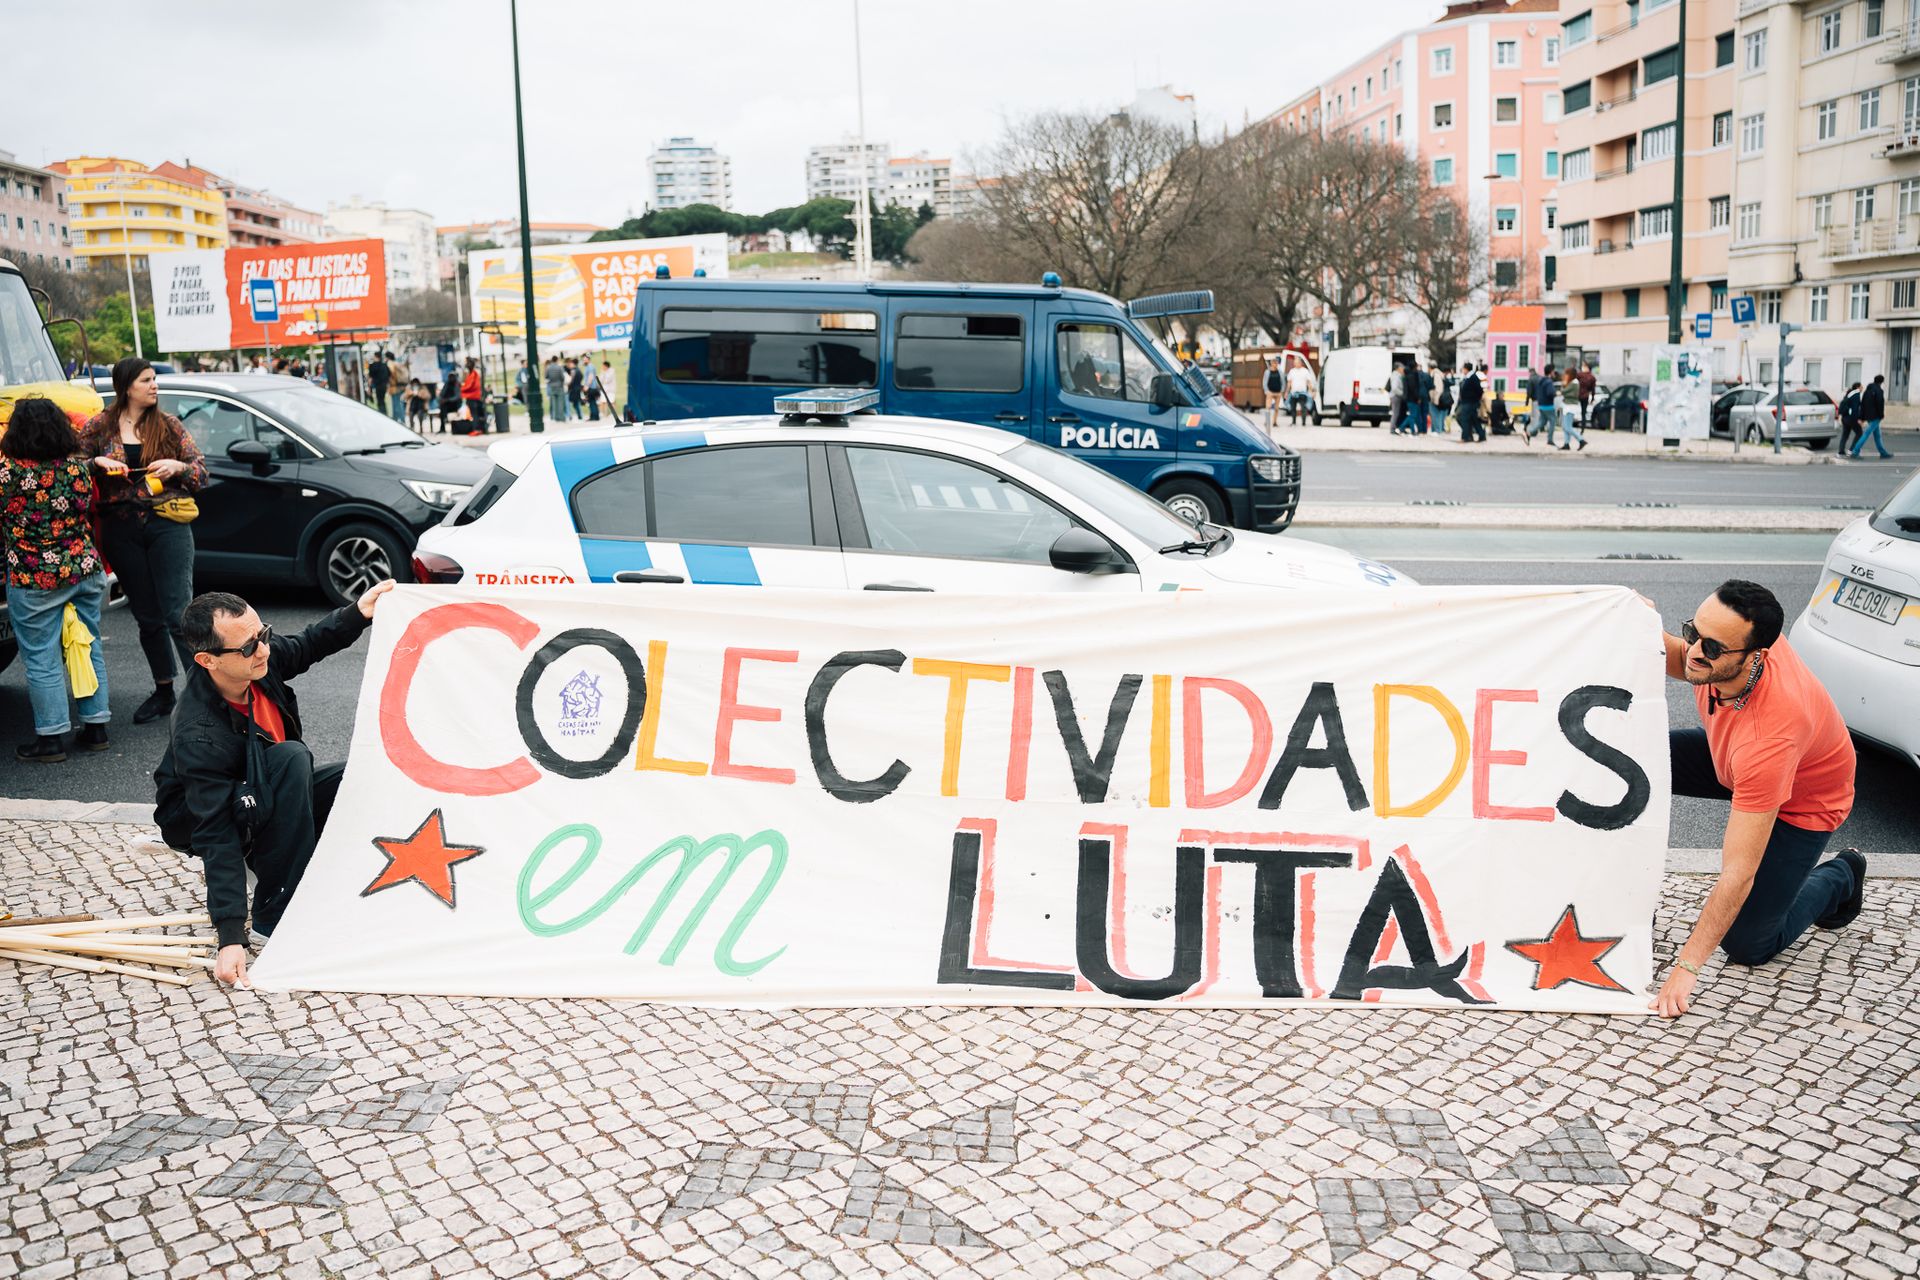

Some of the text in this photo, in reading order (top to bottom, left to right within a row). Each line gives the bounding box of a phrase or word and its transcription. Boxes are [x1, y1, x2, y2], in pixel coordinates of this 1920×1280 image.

[181, 266, 200, 277] POVO
[242, 260, 265, 282] FAZ
[268, 258, 294, 280] DAS
[286, 278, 321, 302] PARA
[324, 274, 371, 299] LUTAR!
[175, 304, 215, 316] AUMENTAR
[1735, 300, 1750, 320] P
[601, 324, 625, 338] NÃO
[1061, 421, 1160, 449] POLÍCIA
[1850, 564, 1874, 580] ZOE
[379, 601, 1651, 831] COLECTIVIDADES
[516, 817, 1498, 1005] em LUTA
